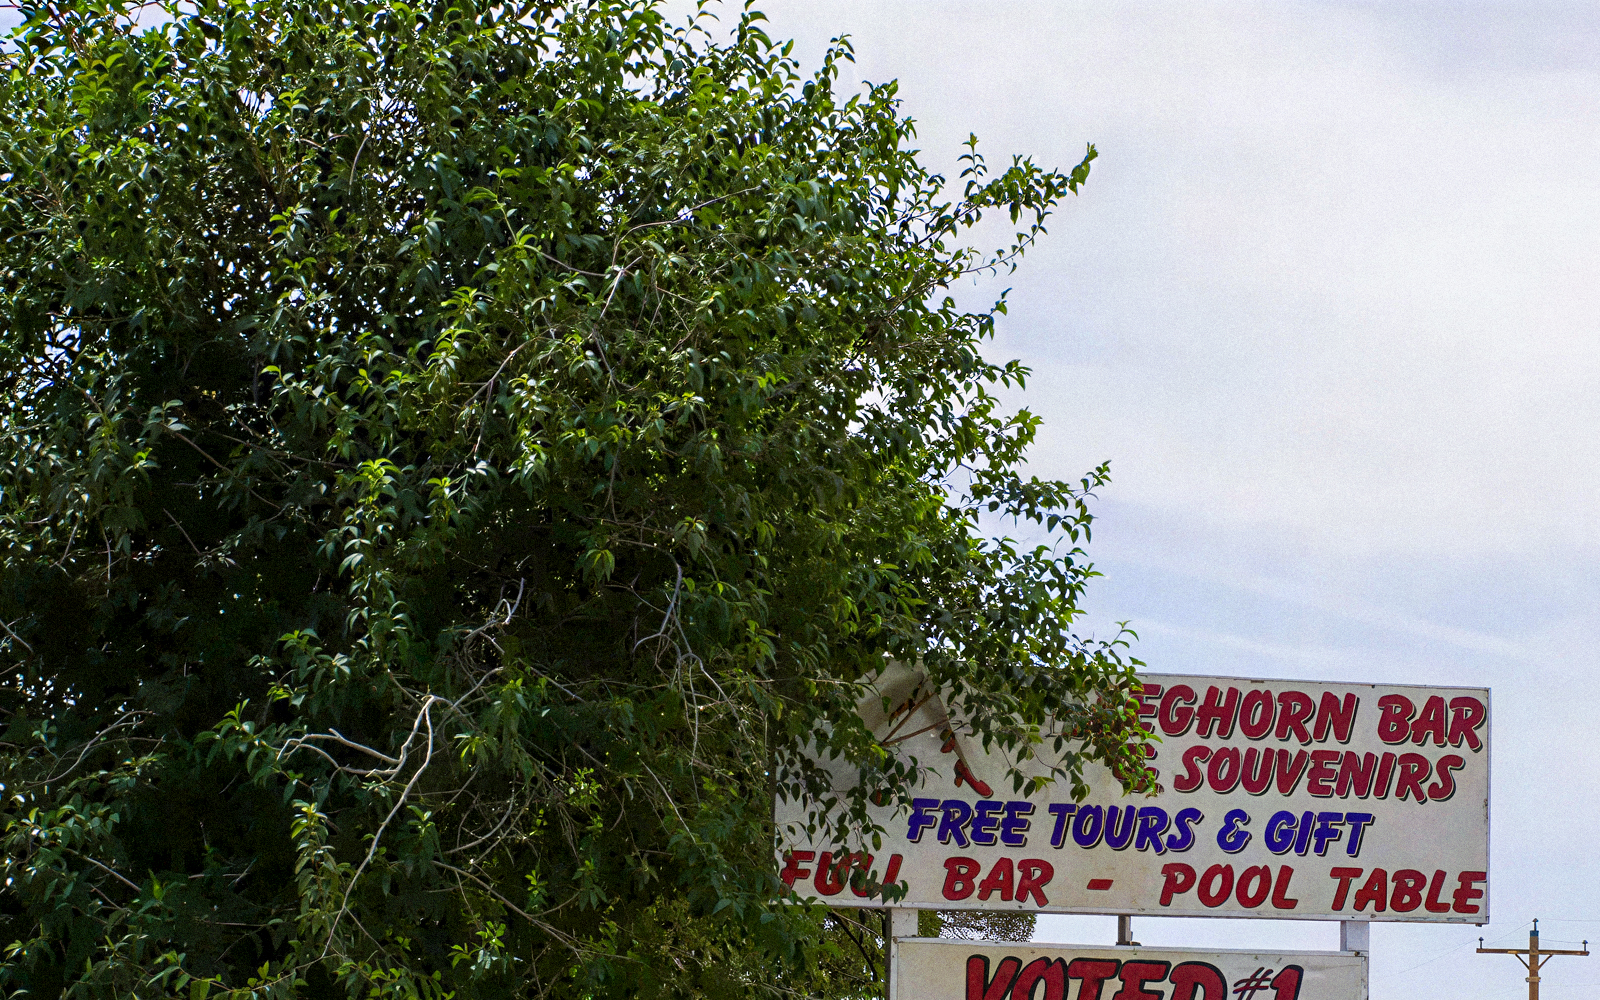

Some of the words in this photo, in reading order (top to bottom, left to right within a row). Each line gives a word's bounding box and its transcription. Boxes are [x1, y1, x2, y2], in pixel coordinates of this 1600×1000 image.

[1126, 683, 1359, 746] EGHORN
[1376, 694, 1486, 752] BAR
[1174, 745, 1466, 805] SOUVENIRS
[906, 798, 1036, 848] FREE
[1048, 803, 1204, 856] TOURS
[1216, 808, 1253, 854] &
[1264, 810, 1375, 858] GIFT
[942, 856, 1055, 908] BAR
[1159, 862, 1299, 909] POOL
[1329, 866, 1486, 914] TABLE
